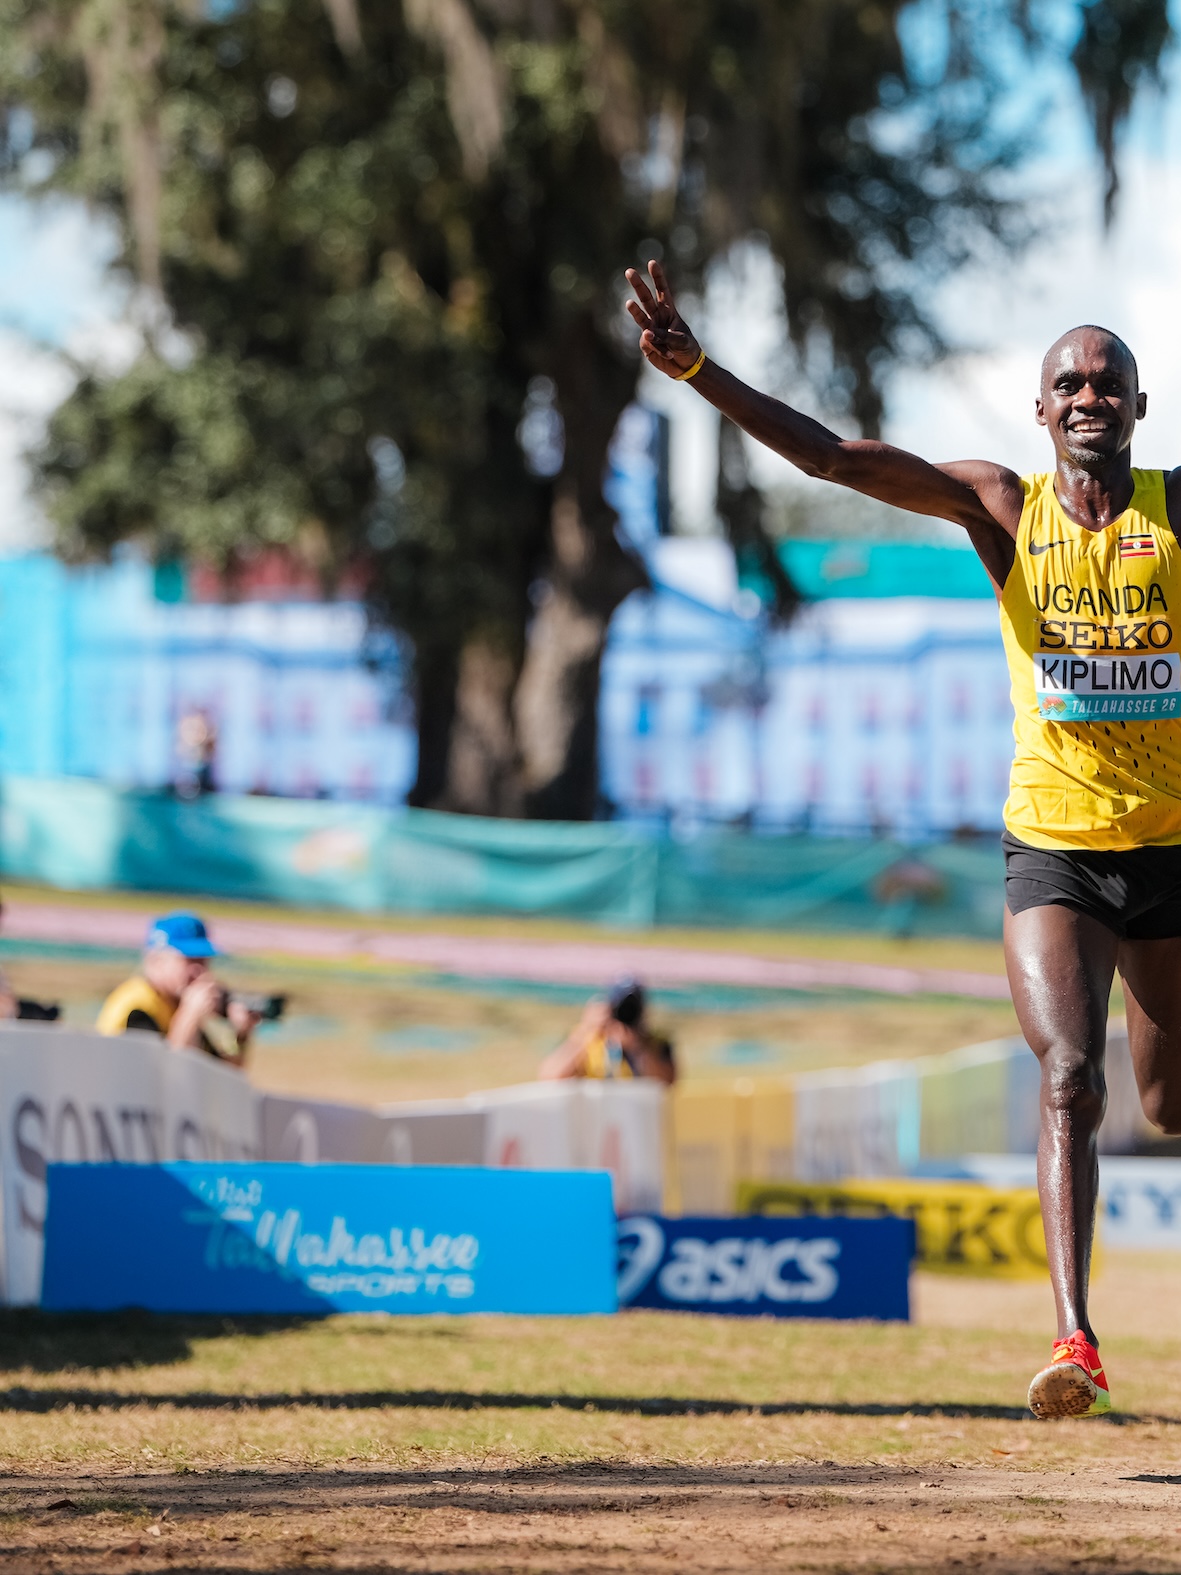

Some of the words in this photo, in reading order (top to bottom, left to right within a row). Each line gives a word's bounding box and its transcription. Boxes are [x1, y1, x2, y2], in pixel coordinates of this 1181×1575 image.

[1034, 583, 1168, 616] UGANDA
[1039, 620, 1173, 650] SEIKO
[1041, 659, 1173, 690] KIPLIMO
[1072, 699, 1156, 714] TALLAHASSEE
[1161, 697, 1176, 712] 26
[658, 1237, 842, 1303] asics
